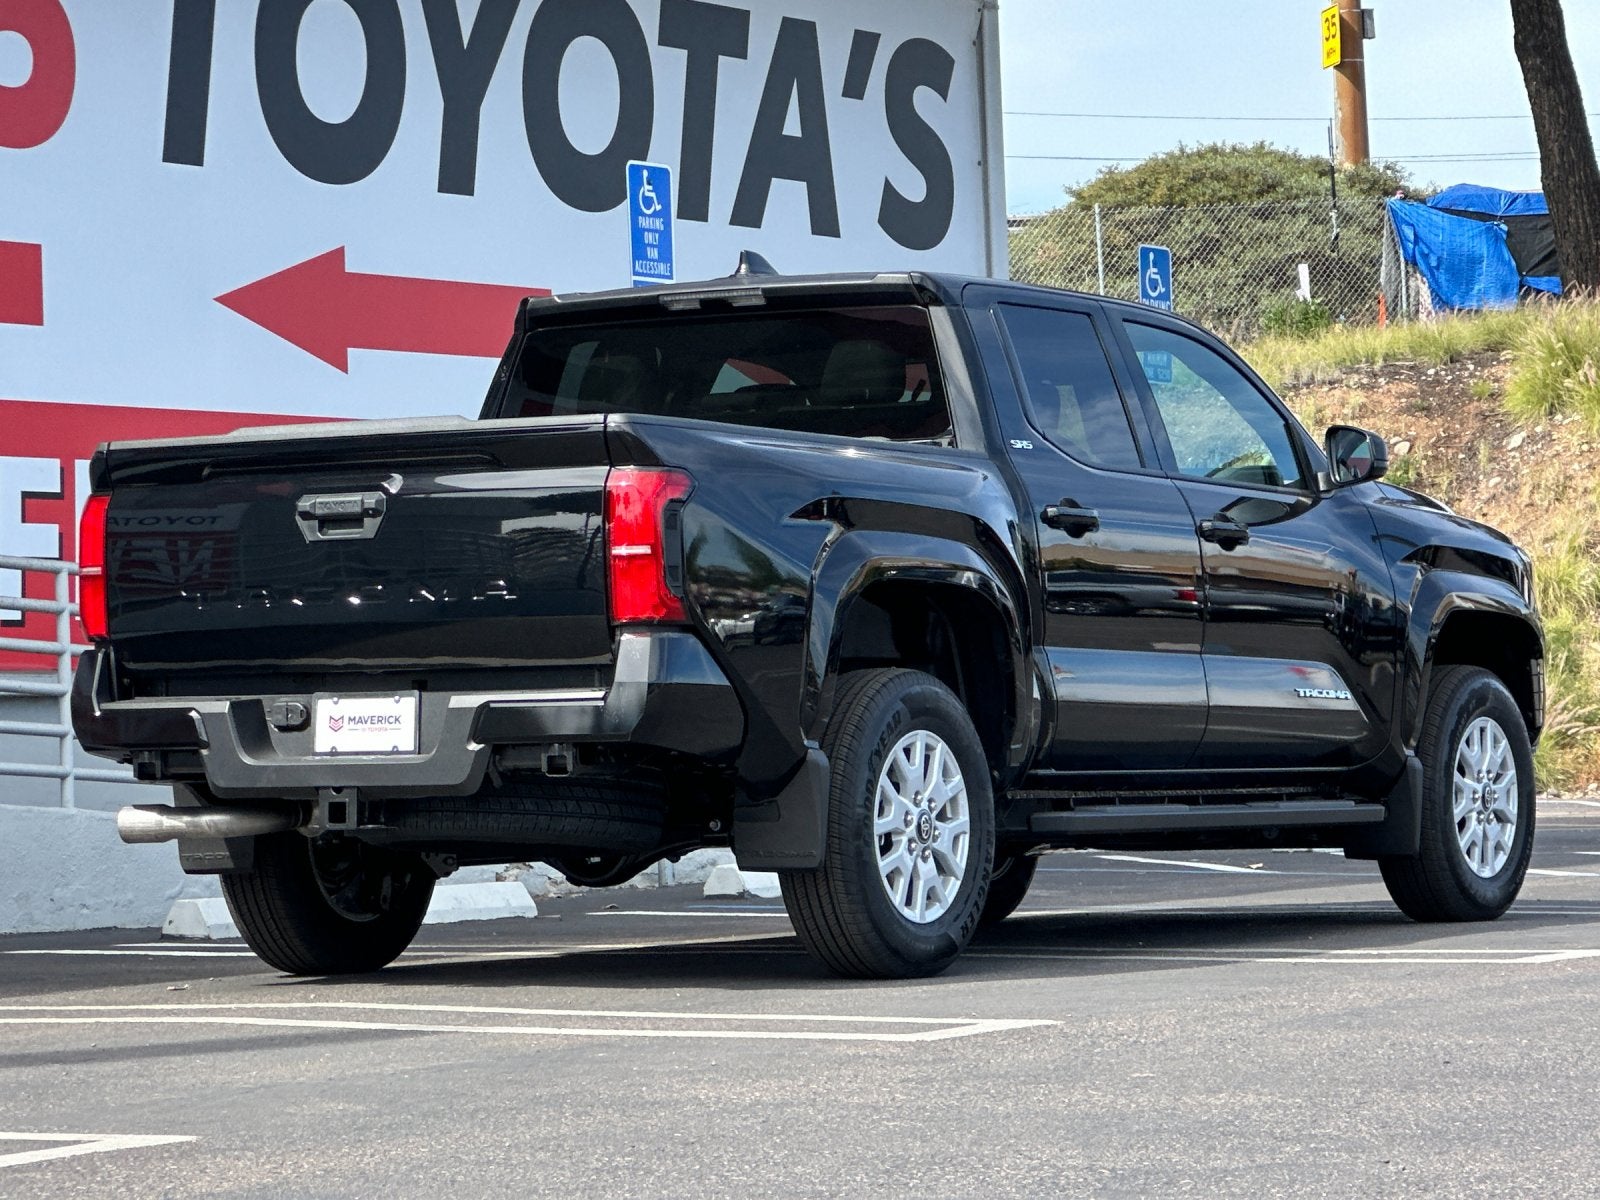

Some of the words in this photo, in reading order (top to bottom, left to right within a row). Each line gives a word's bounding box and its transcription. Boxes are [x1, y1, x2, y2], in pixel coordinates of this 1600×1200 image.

[1325, 14, 1337, 41] 35
[638, 216, 664, 230] PARKING
[644, 231, 659, 245] ONLY
[647, 247, 659, 260] VAN
[635, 260, 671, 275] ACCESSIBLE
[1010, 440, 1033, 449] SR5
[319, 501, 359, 512] TOYOTA
[1294, 688, 1351, 700] TACOMA
[347, 714, 402, 726] MAVERICK
